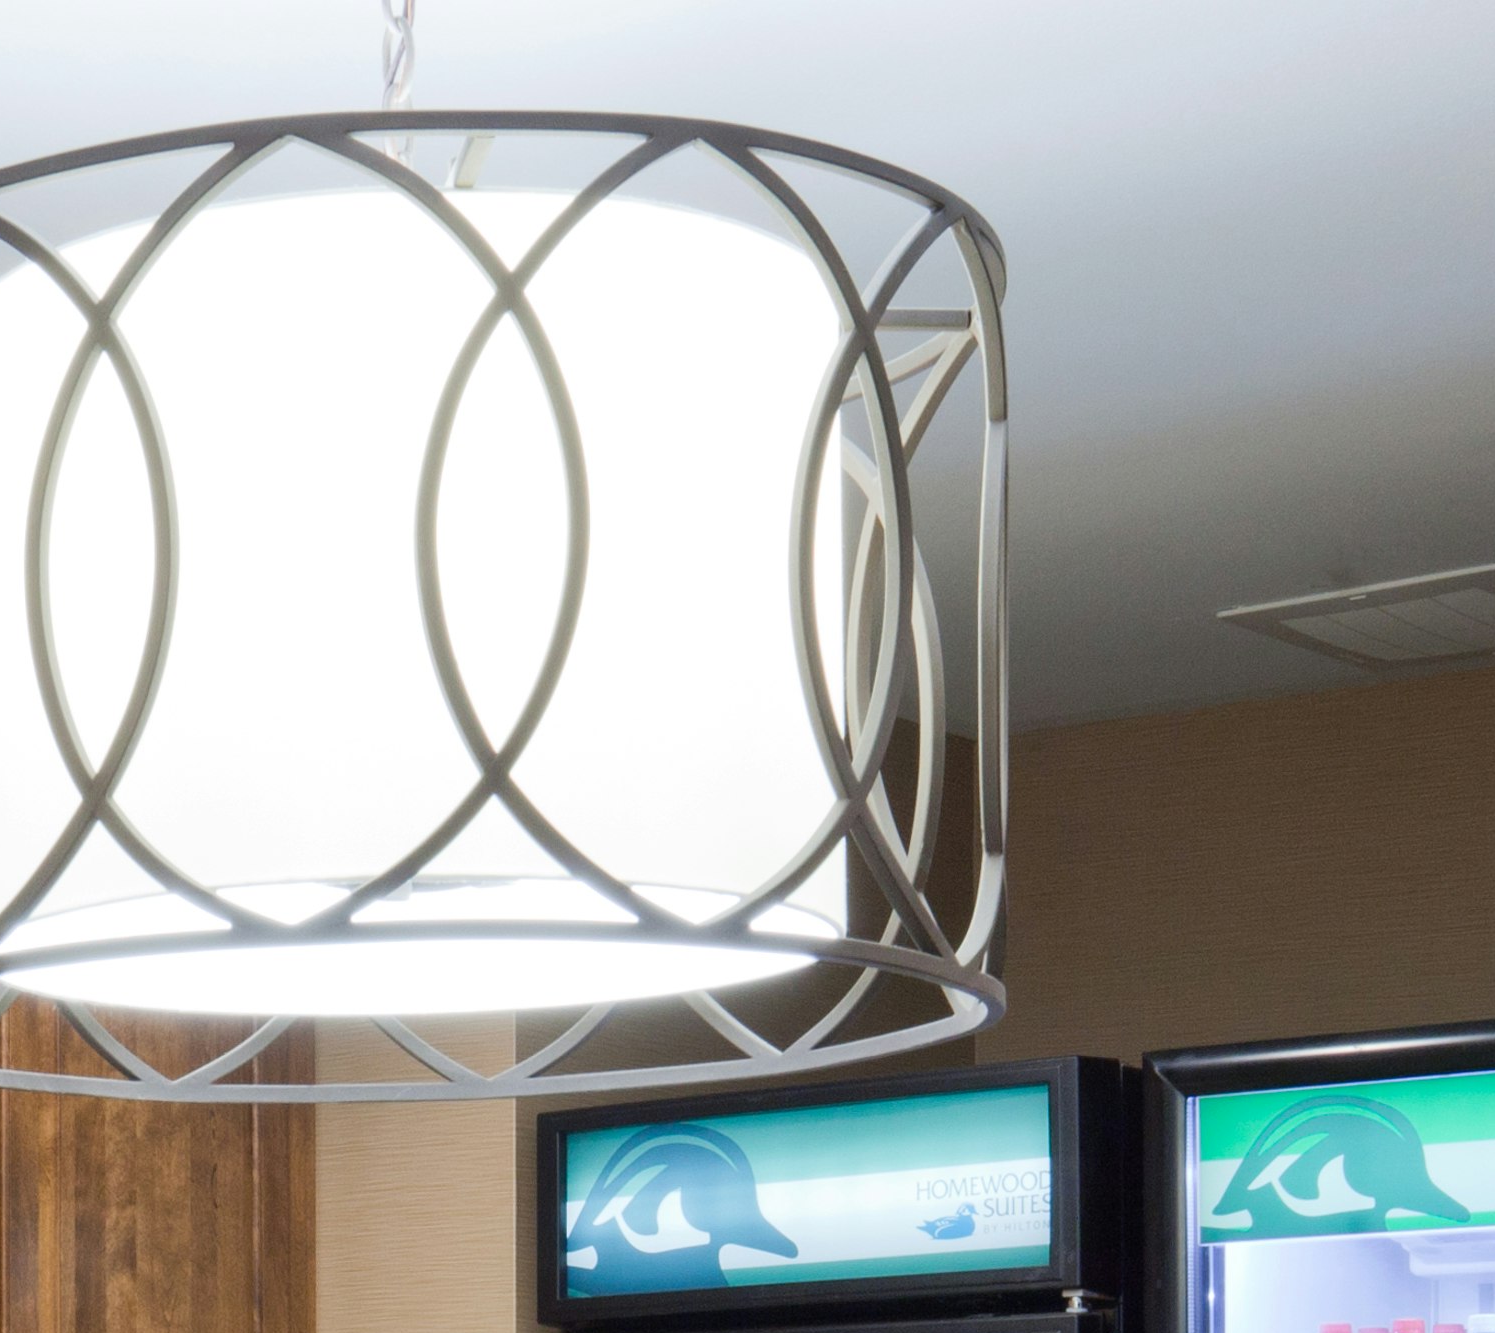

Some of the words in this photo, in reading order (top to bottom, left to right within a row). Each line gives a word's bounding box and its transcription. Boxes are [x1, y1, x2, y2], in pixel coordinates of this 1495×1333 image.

[916, 1170, 1051, 1201] HOMEWOOD
[984, 1194, 1051, 1219] SUITES
[984, 1224, 999, 1235] BY
[1004, 1219, 1051, 1234] HILTON
